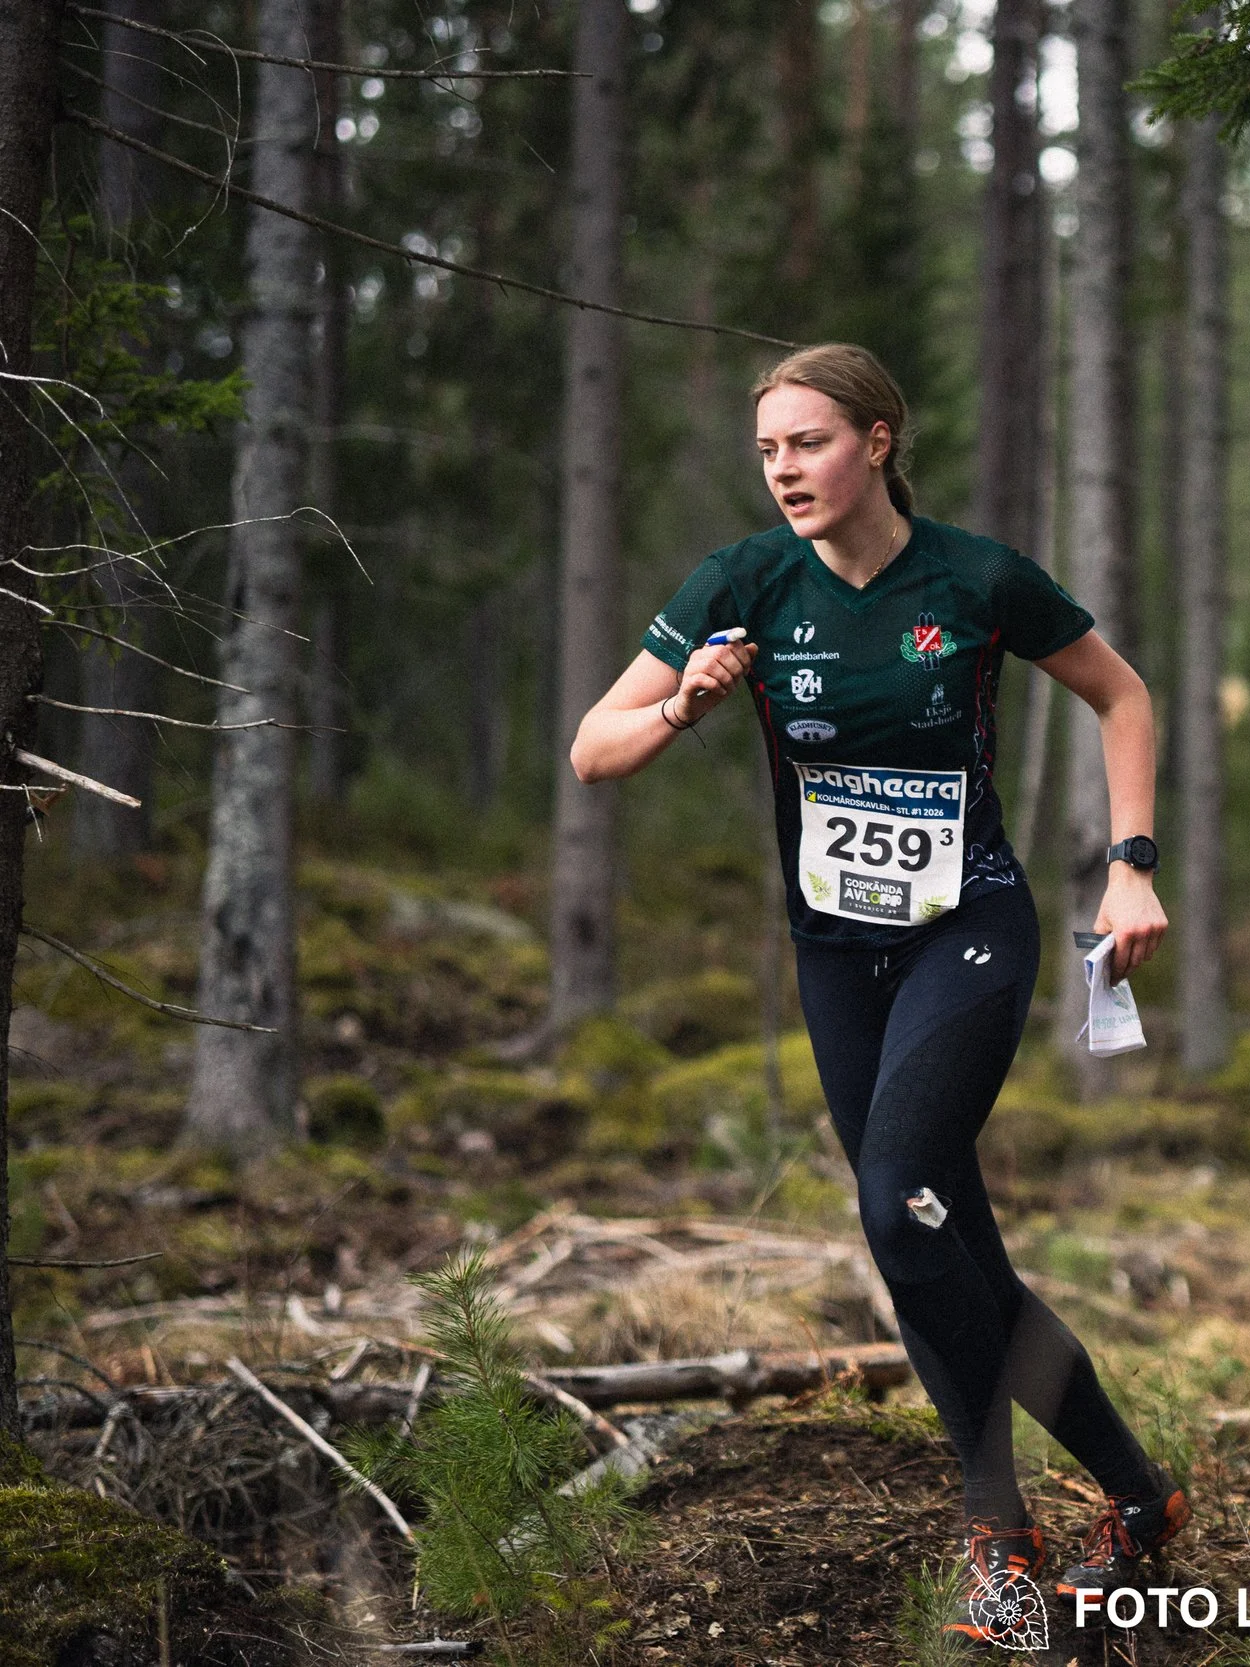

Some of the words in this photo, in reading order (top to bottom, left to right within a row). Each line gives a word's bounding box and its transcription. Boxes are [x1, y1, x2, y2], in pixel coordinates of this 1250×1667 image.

[773, 651, 840, 662] Handelsbanken
[910, 709, 963, 729] Stadshotell
[803, 766, 960, 800] bagheera
[817, 793, 890, 812] KOLMÅRDSKAVLEN
[896, 806, 910, 816] STL
[911, 807, 922, 816] #1
[923, 808, 944, 817] 2026
[826, 816, 932, 872] 259
[939, 827, 954, 846] 3
[845, 877, 904, 896] GODKÄNDA
[844, 889, 902, 908] AVLOPP
[855, 903, 884, 913] SVERIGE
